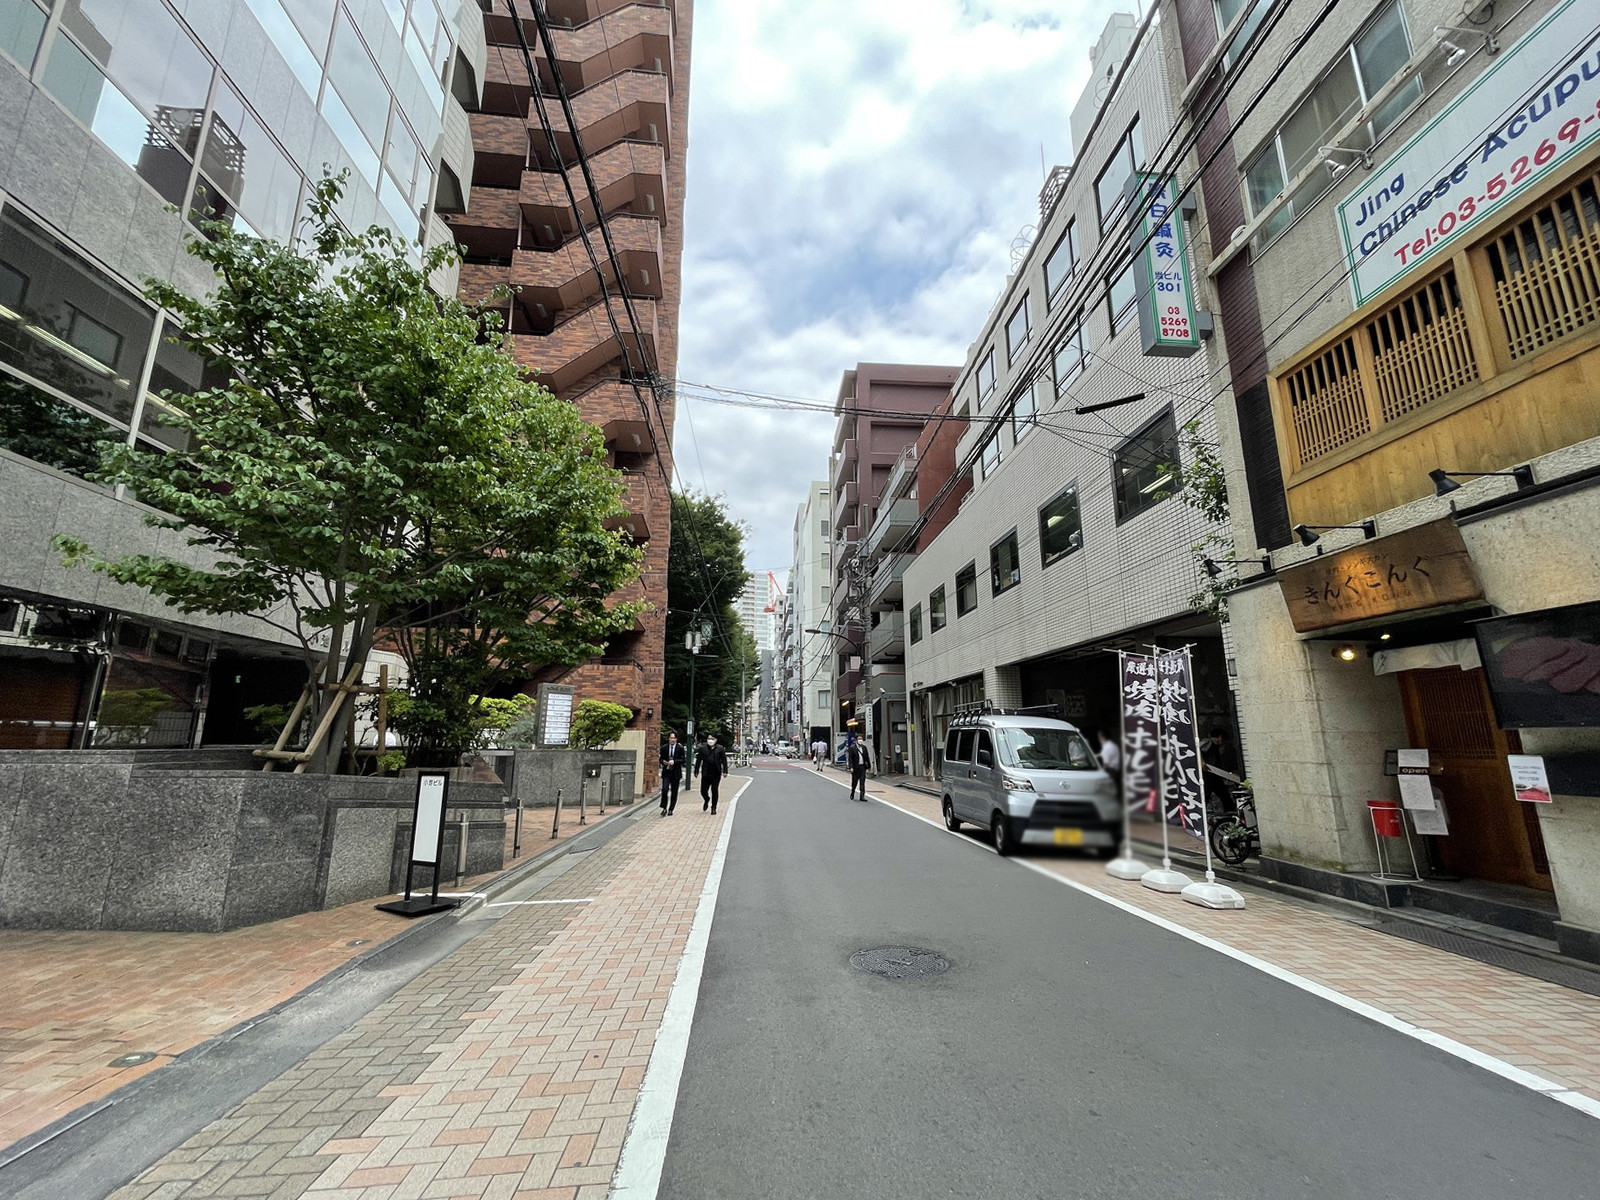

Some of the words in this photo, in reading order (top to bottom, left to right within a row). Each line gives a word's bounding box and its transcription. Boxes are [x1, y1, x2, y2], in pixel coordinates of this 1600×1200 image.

[1394, 98, 1600, 265] Tel:03-5269-
[1355, 172, 1405, 227] Jing
[1360, 162, 1468, 256] Chinese
[1157, 281, 1181, 293] 301
[1167, 306, 1180, 315] 03
[1161, 316, 1188, 326] 5269
[1162, 327, 1190, 338] 8708
[1304, 555, 1430, 605] きんぐこんぐ
[1401, 767, 1429, 775] open
